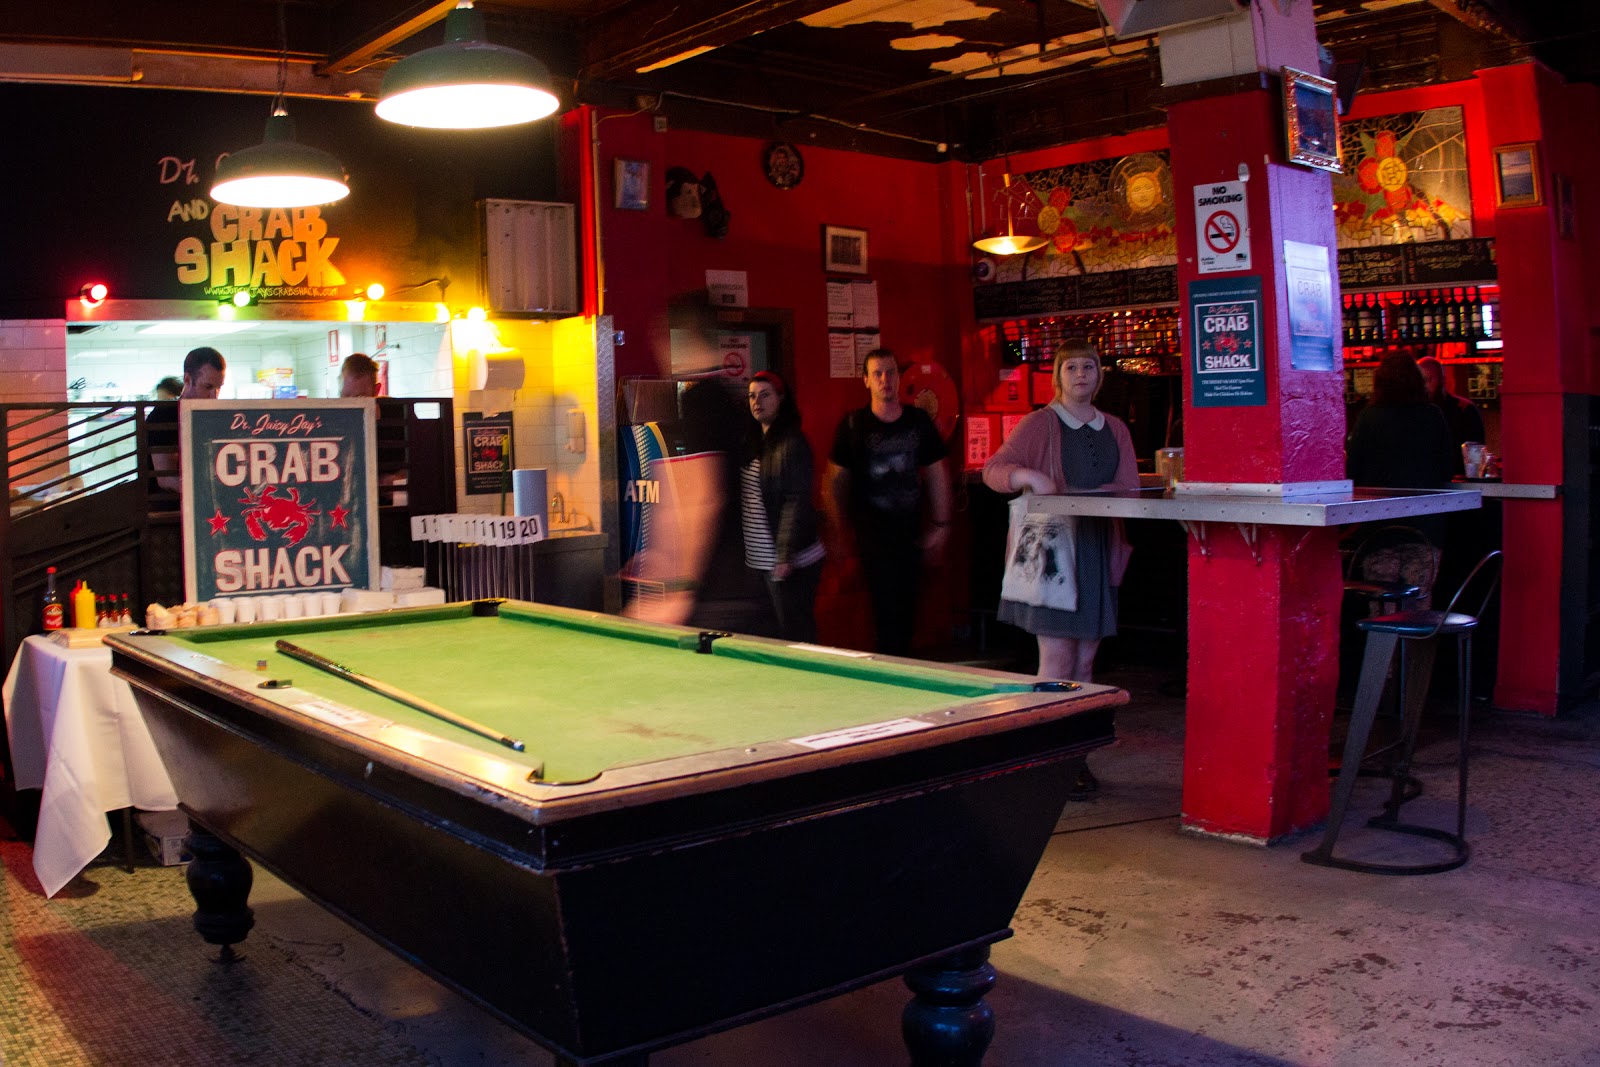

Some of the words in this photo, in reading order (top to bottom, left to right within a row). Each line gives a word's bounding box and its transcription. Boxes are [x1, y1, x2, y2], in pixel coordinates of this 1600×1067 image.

[1198, 194, 1243, 207] SMOKING
[1212, 186, 1227, 195] NO
[167, 199, 209, 223] AND
[210, 203, 328, 243] CRAB
[174, 237, 347, 287] SHACK
[1297, 281, 1323, 298] CRAB
[1203, 315, 1249, 334] CRAB
[1204, 354, 1251, 369] SHACK
[230, 413, 252, 430] Dr.
[252, 413, 289, 436] Juicy
[287, 413, 323, 436] Jay's
[215, 441, 341, 487] CRAB
[624, 479, 660, 504] ATM
[499, 520, 516, 539] 19
[520, 518, 538, 538] 20
[214, 544, 353, 592] SHACK
